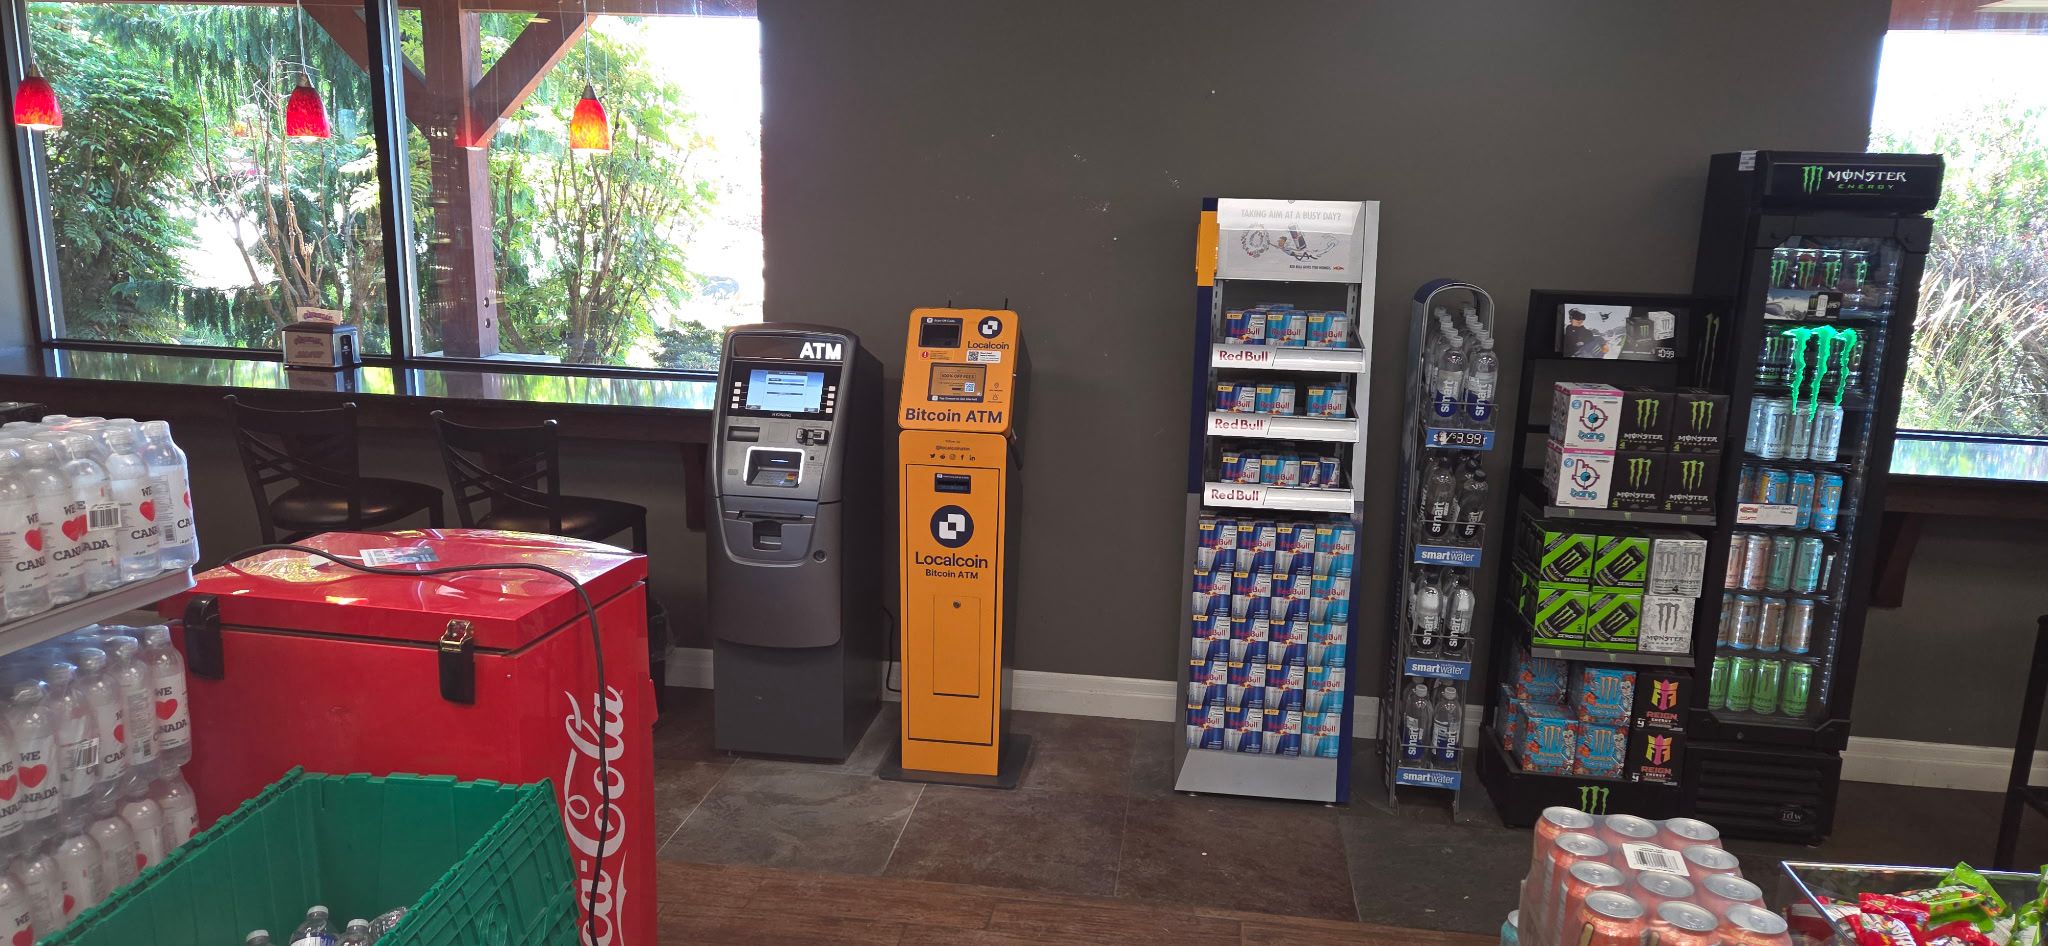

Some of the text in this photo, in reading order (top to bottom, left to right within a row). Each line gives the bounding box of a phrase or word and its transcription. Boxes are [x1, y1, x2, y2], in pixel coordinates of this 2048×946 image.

[1826, 168, 1907, 182] MONSTER
[1241, 209, 1341, 221] TAKING AIM AT A BUSY DAY?
[800, 342, 842, 360] ATM
[967, 340, 1010, 350] Localcoin
[1219, 350, 1268, 362] Red Bull
[906, 408, 1002, 424] Bitcoin ATM
[1215, 418, 1263, 430] Red Bull
[1578, 430, 1605, 442] bang
[1678, 435, 1718, 443] MONSTER
[1211, 489, 1259, 501] Red Bull
[1570, 488, 1597, 500] bang
[1616, 492, 1656, 500] MONSTER
[915, 552, 988, 569] Localcoin
[1421, 550, 1475, 562] smartwater
[925, 569, 979, 579] Bitcoin ATM
[1412, 663, 1464, 675] smartwater
[1646, 711, 1678, 719] REIGN
[20, 751, 40, 762] WE
[1641, 766, 1672, 774] REIGN
[1403, 771, 1455, 784] smartwater
